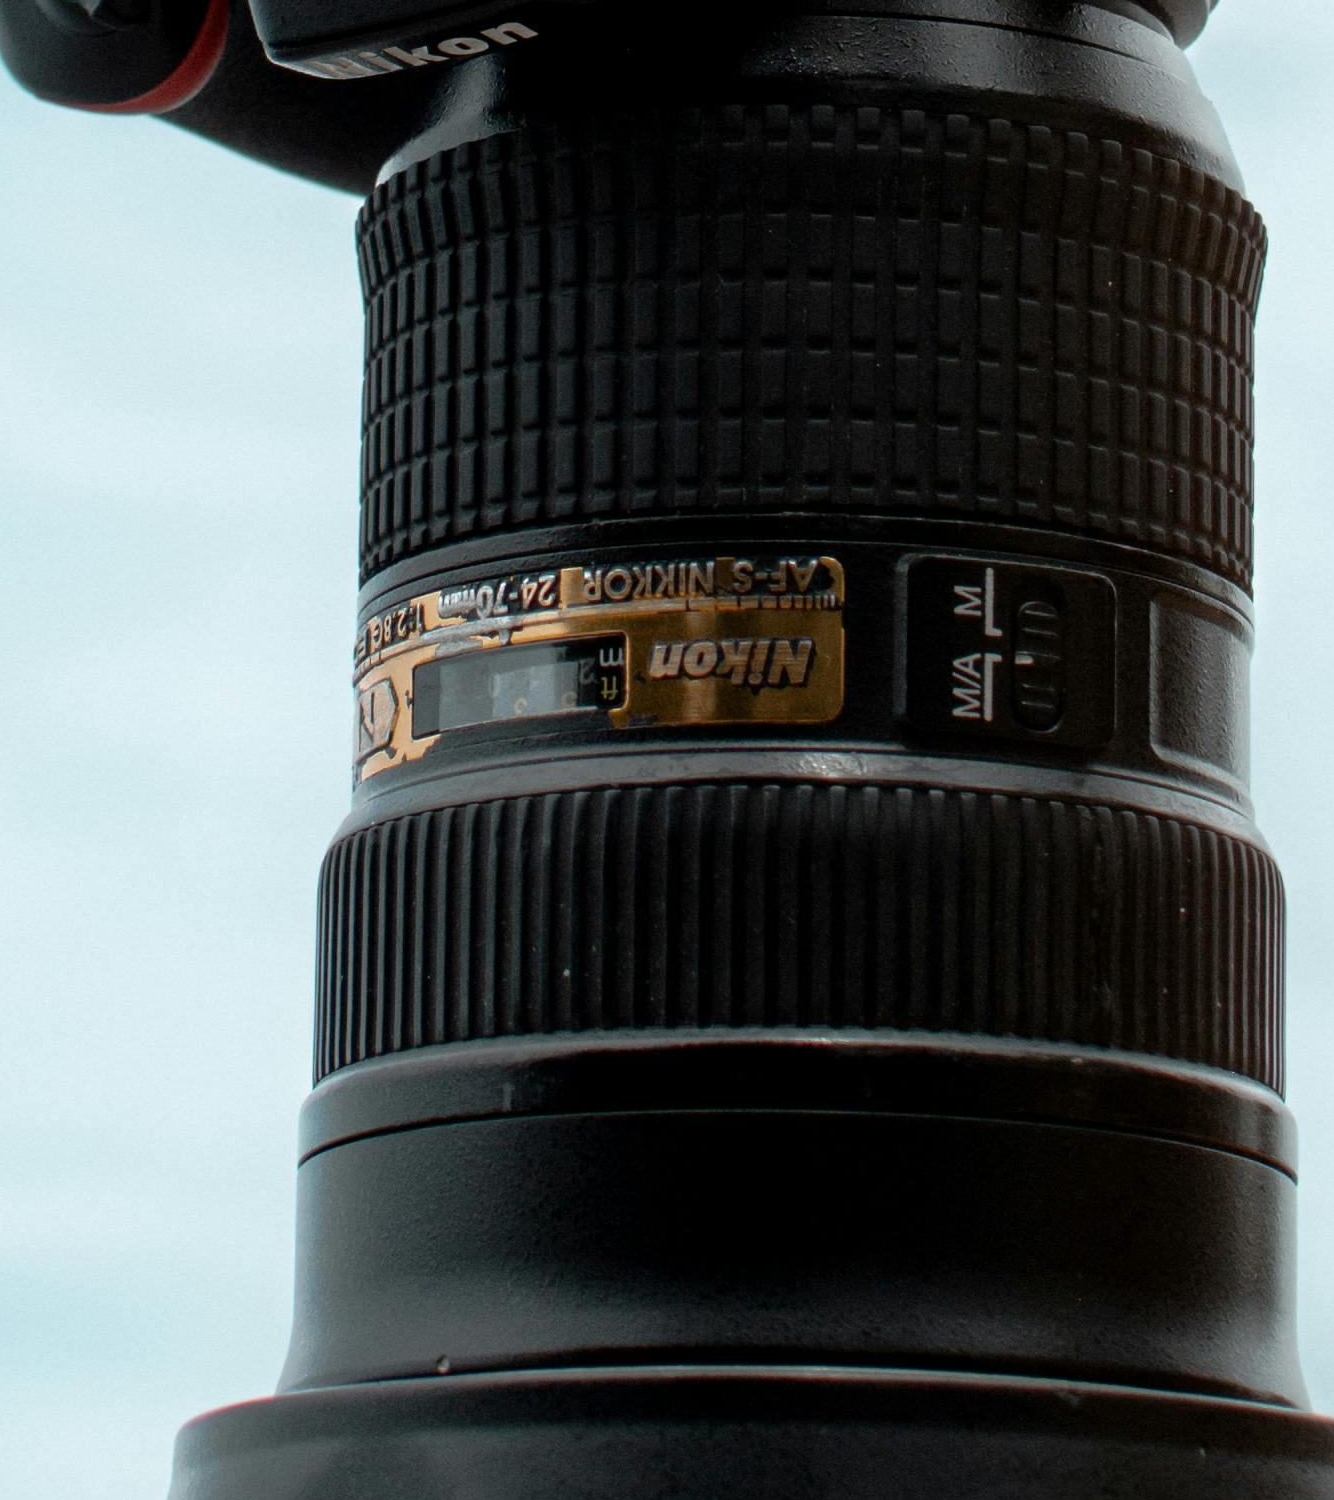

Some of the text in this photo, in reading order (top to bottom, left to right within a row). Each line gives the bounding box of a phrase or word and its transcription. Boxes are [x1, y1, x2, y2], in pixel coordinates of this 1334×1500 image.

[305, 21, 539, 79] Nikon
[438, 573, 558, 620] 24-70mm
[581, 560, 716, 604] NIKKOR
[732, 557, 820, 594] AF-S
[953, 584, 983, 617] M
[599, 647, 624, 668] m
[648, 638, 813, 688] Nikon
[601, 675, 619, 701] ft
[951, 652, 982, 720] M/A
